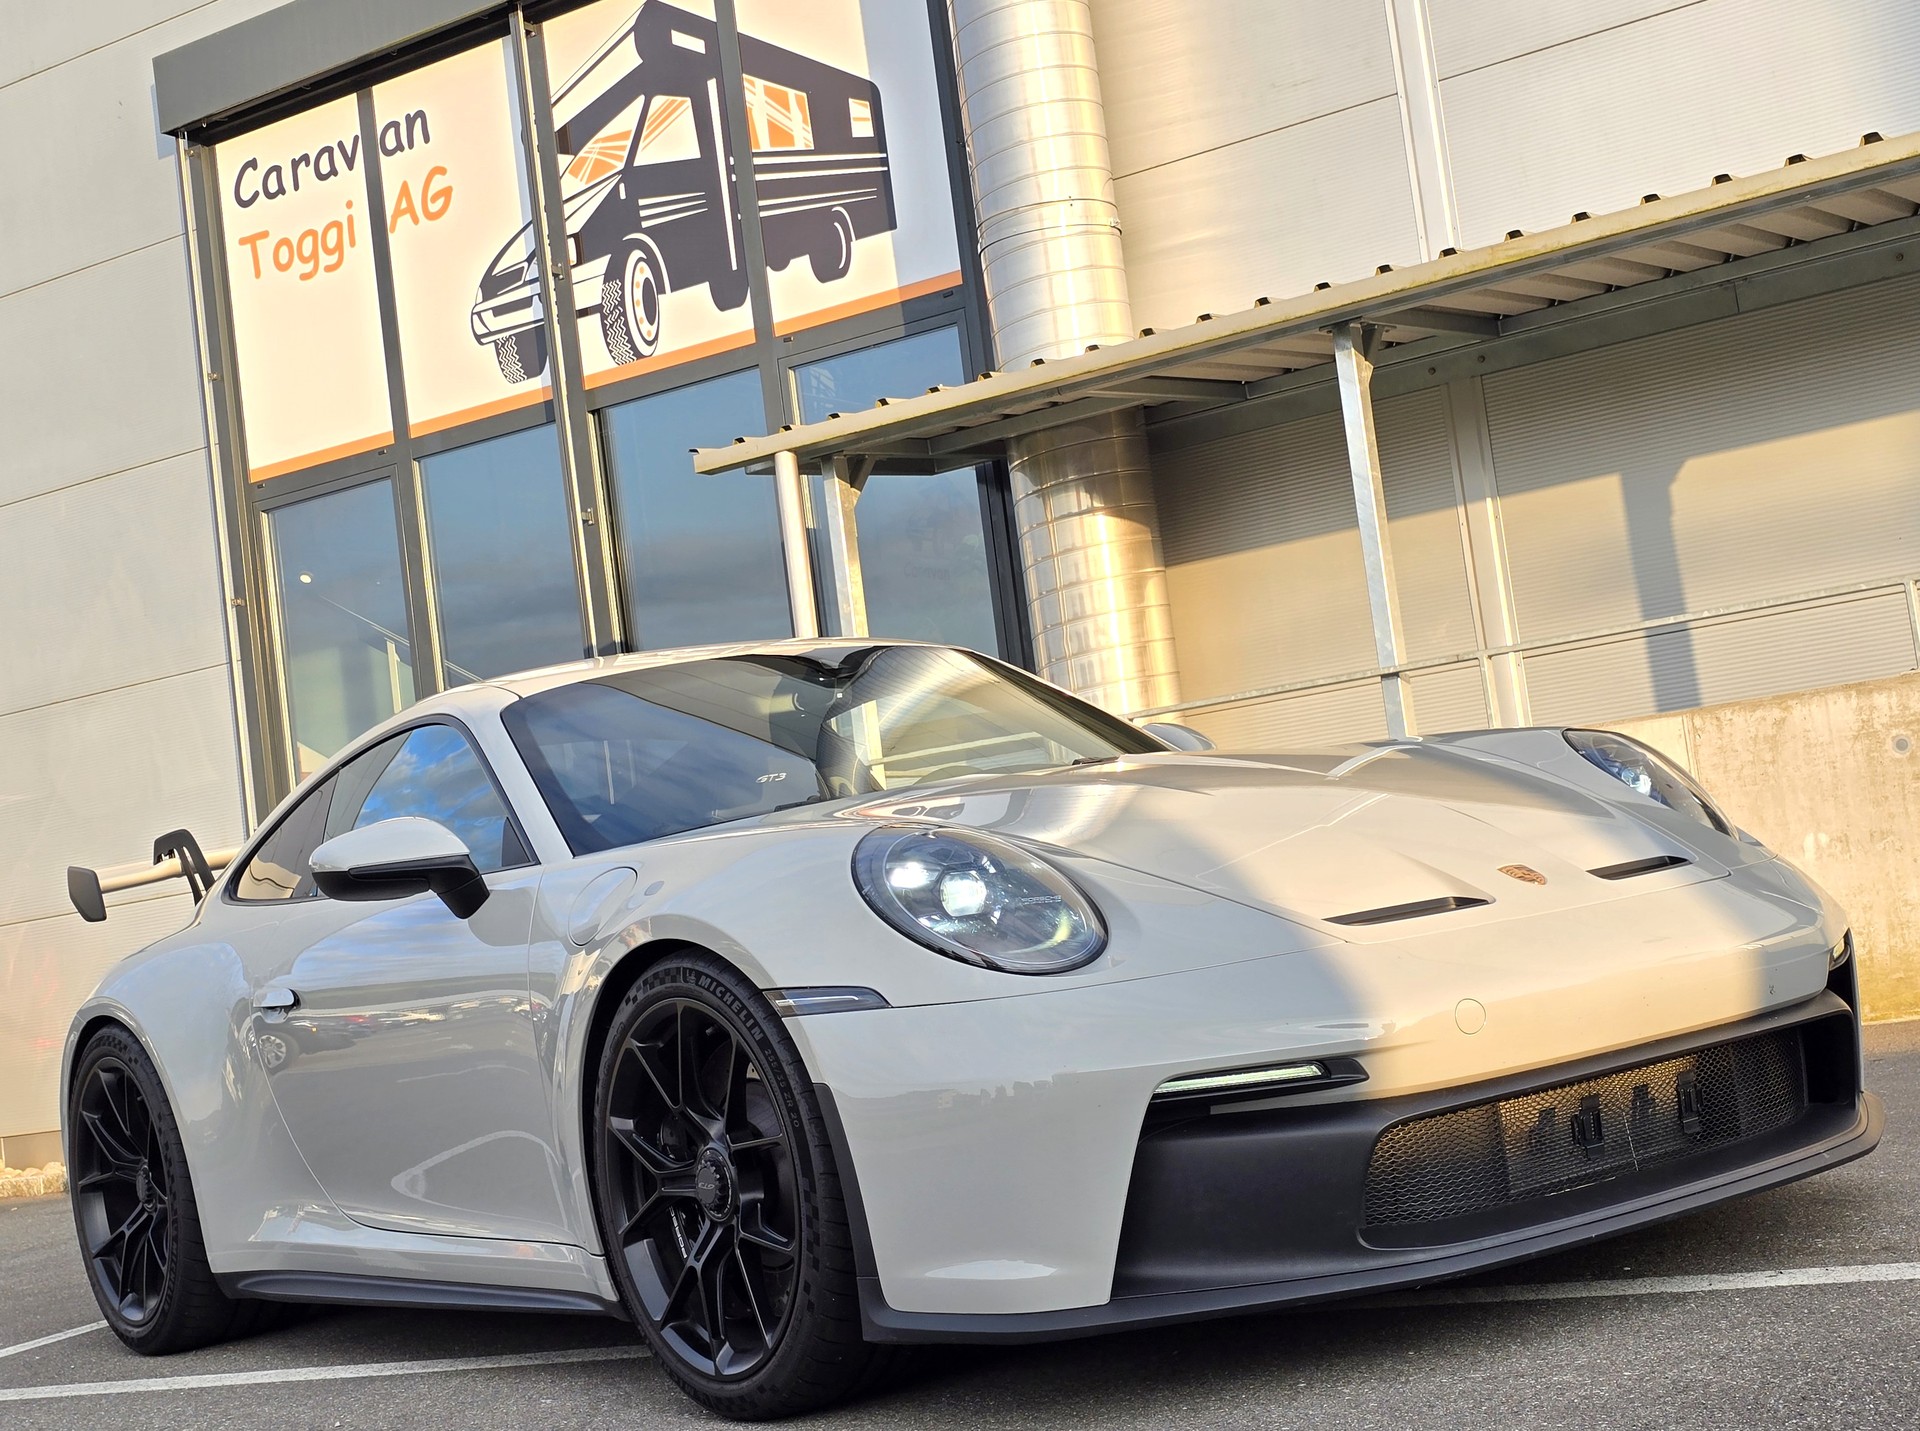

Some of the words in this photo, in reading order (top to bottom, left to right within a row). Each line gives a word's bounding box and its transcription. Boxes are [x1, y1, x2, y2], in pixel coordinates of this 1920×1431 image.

[234, 109, 431, 209] Caravan
[238, 199, 356, 281] Toggi
[389, 165, 453, 234] AG
[755, 772, 787, 783] GT3
[698, 975, 764, 1041] MICHELIN
